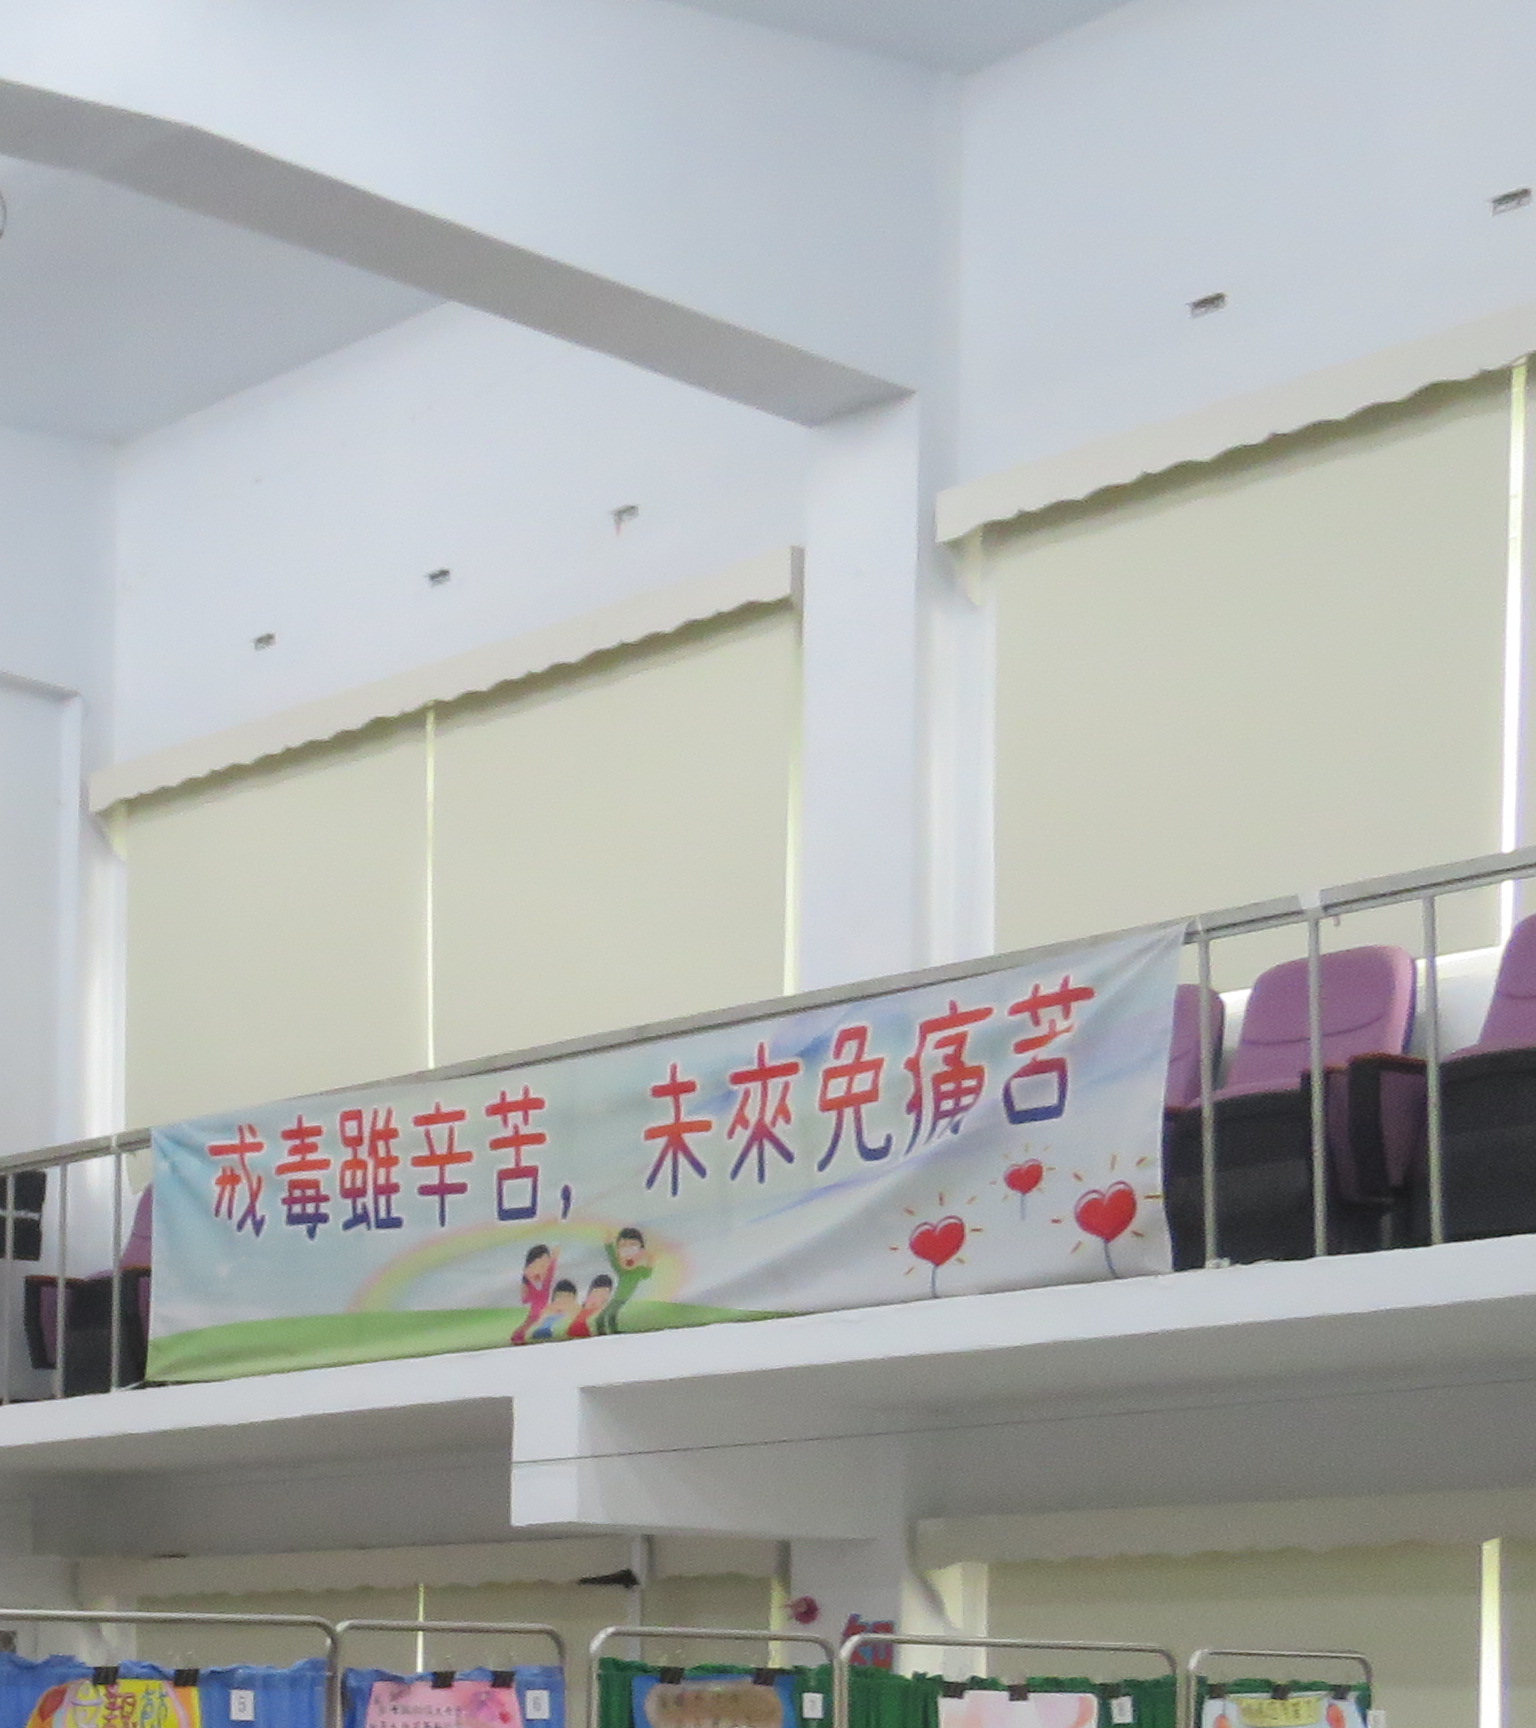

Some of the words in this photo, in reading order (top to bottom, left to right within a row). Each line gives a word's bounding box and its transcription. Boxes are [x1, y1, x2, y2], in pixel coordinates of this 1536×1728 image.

[644, 974, 1096, 1198] 未來免痛苦
